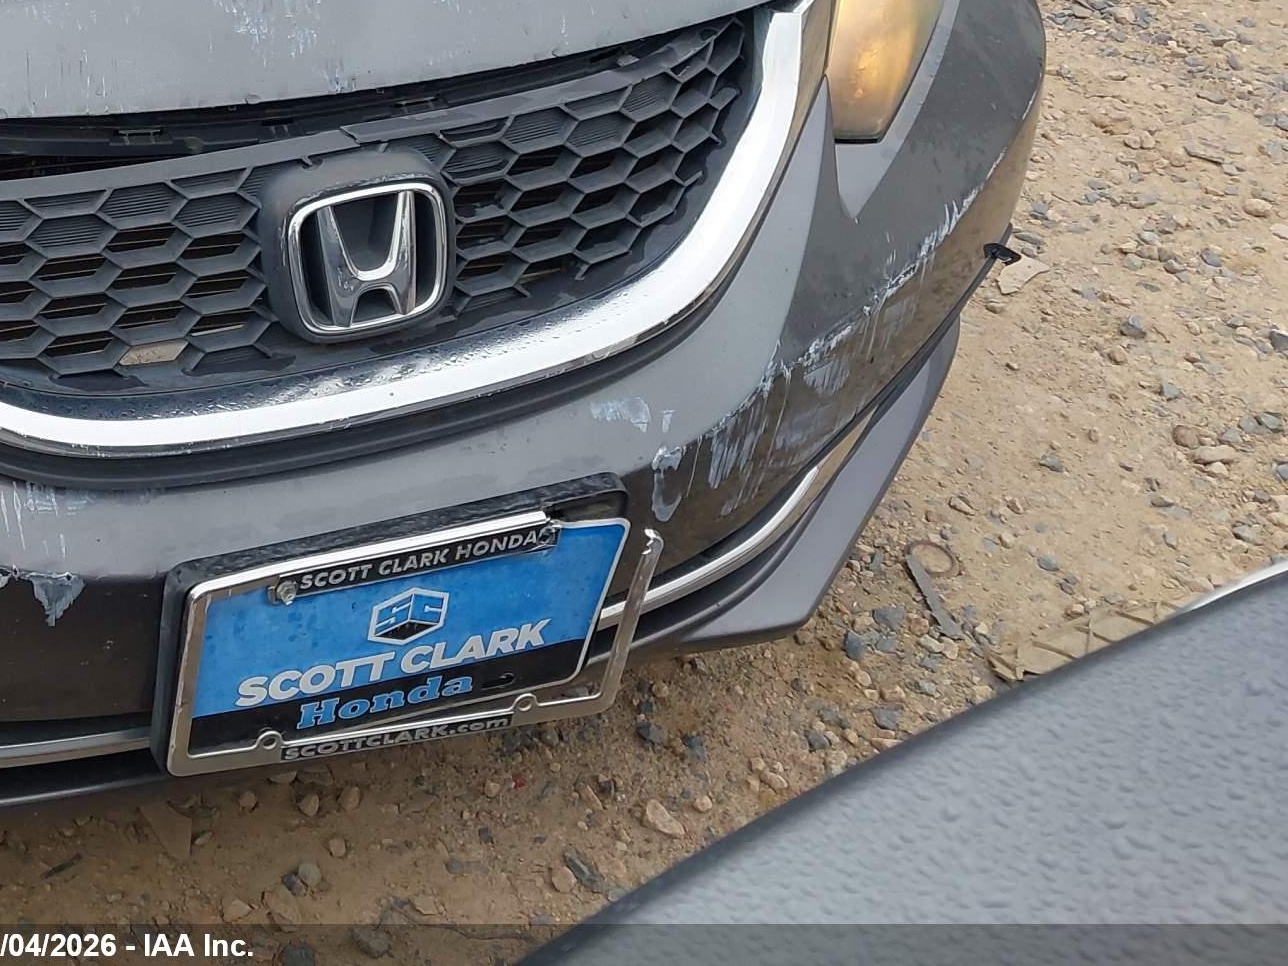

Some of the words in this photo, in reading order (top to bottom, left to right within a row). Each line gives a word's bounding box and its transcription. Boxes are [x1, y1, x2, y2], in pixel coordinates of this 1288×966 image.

[300, 564, 373, 590] SCOTT
[378, 548, 450, 576] CLARK
[455, 530, 537, 560] HONDA
[235, 651, 397, 707] SCOTT
[399, 618, 551, 674] CLARK
[296, 674, 474, 730] Honda
[284, 717, 509, 760] SCOTTCLARK.com
